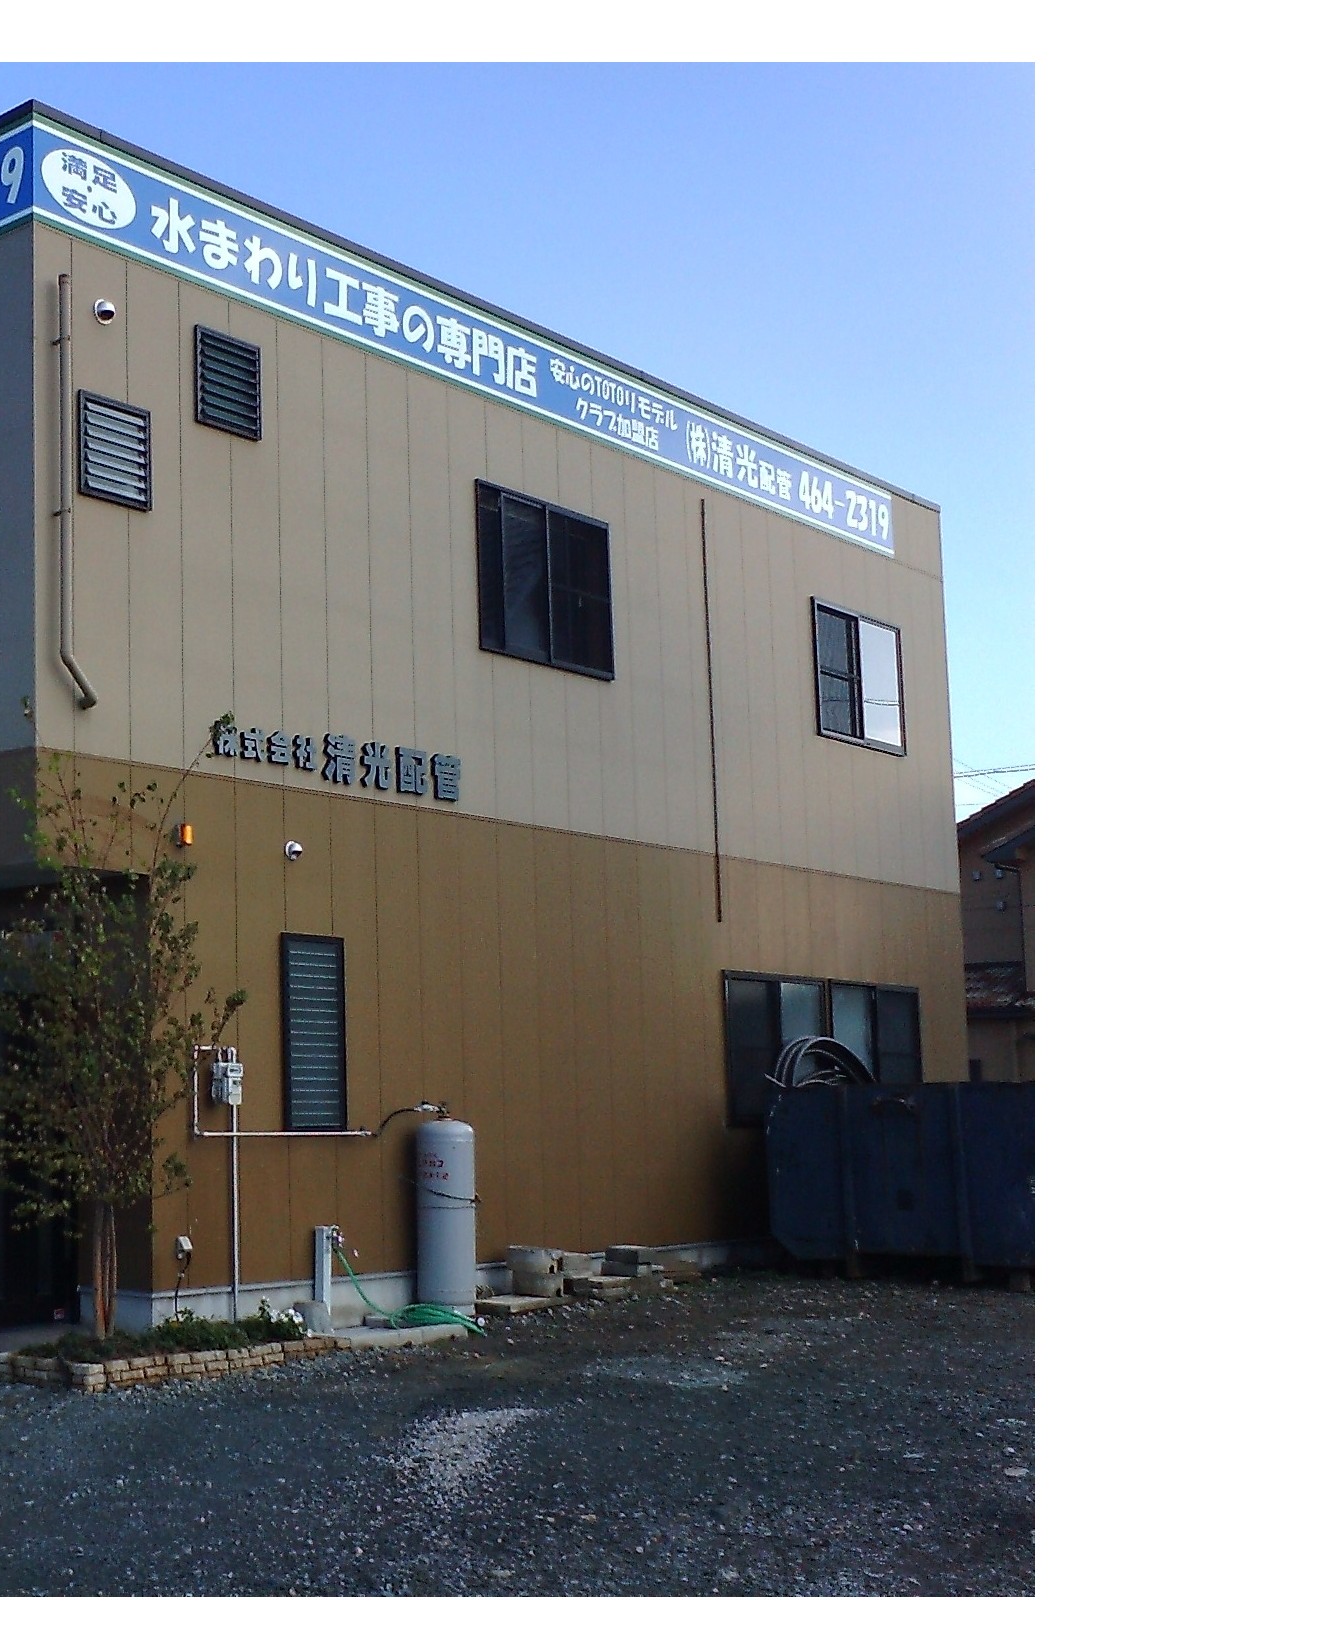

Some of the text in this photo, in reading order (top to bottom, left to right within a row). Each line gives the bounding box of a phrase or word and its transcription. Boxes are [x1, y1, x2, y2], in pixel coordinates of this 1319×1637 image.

[61, 151, 117, 194] 満足
[61, 186, 117, 225] 安心
[150, 197, 538, 399] 水まわり工事の専門店
[549, 358, 678, 431] 安心のTOTOリモデル
[798, 470, 890, 540] 464-2319
